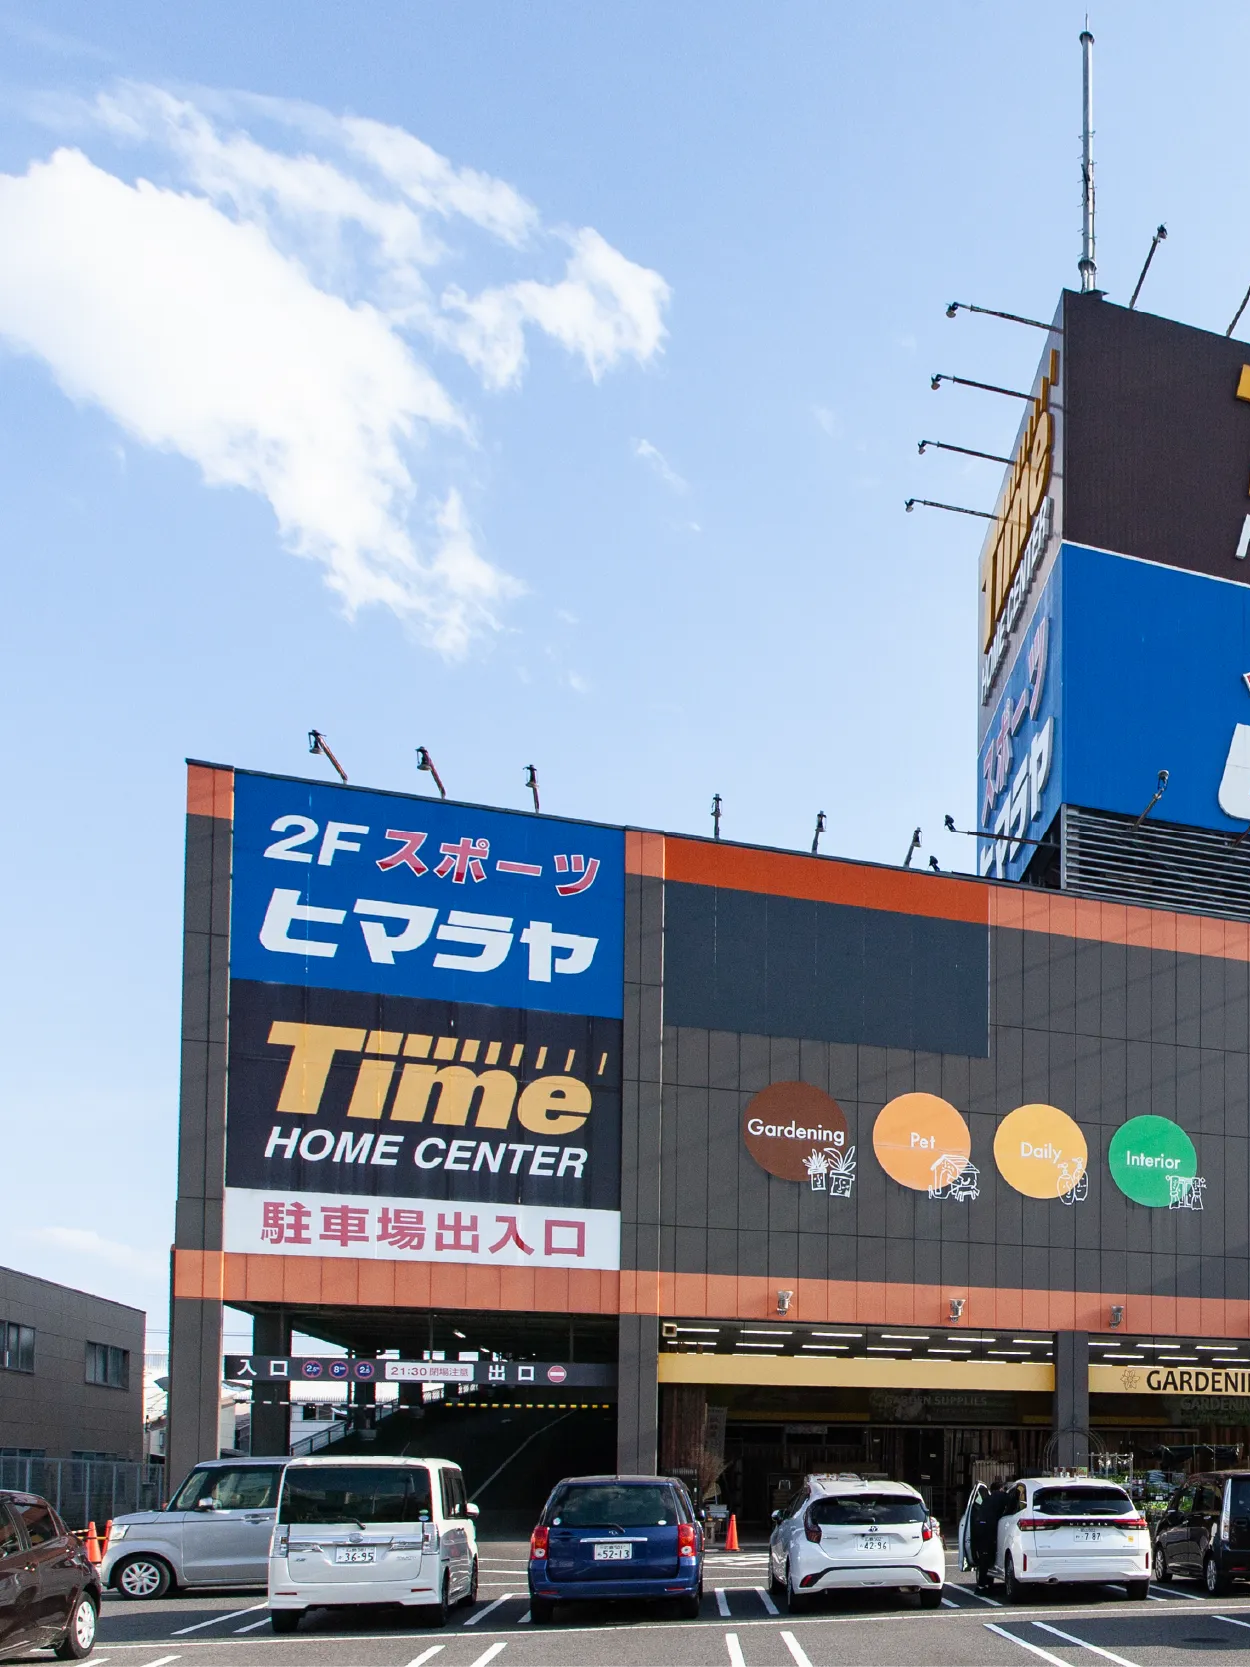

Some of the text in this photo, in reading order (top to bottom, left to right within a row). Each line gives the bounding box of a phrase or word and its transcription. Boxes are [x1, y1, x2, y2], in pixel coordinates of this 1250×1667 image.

[981, 349, 1057, 655] Time
[1007, 496, 1050, 633] CENTER
[982, 616, 1049, 829] スポーツ
[263, 815, 601, 897] 2F スポーツ
[259, 888, 599, 982] ヒマラヤ
[267, 1021, 607, 1135] Time
[264, 1127, 588, 1179] HOME CENTER
[747, 1119, 845, 1146] Gardening
[911, 1132, 935, 1149] Pet
[1020, 1142, 1062, 1164] Daily
[1126, 1151, 1180, 1170] Interior
[260, 1202, 587, 1257] 駐車場出入口
[391, 1366, 427, 1376] 21:30
[345, 1552, 374, 1561] 36-95
[603, 1550, 630, 1558] 52-13
